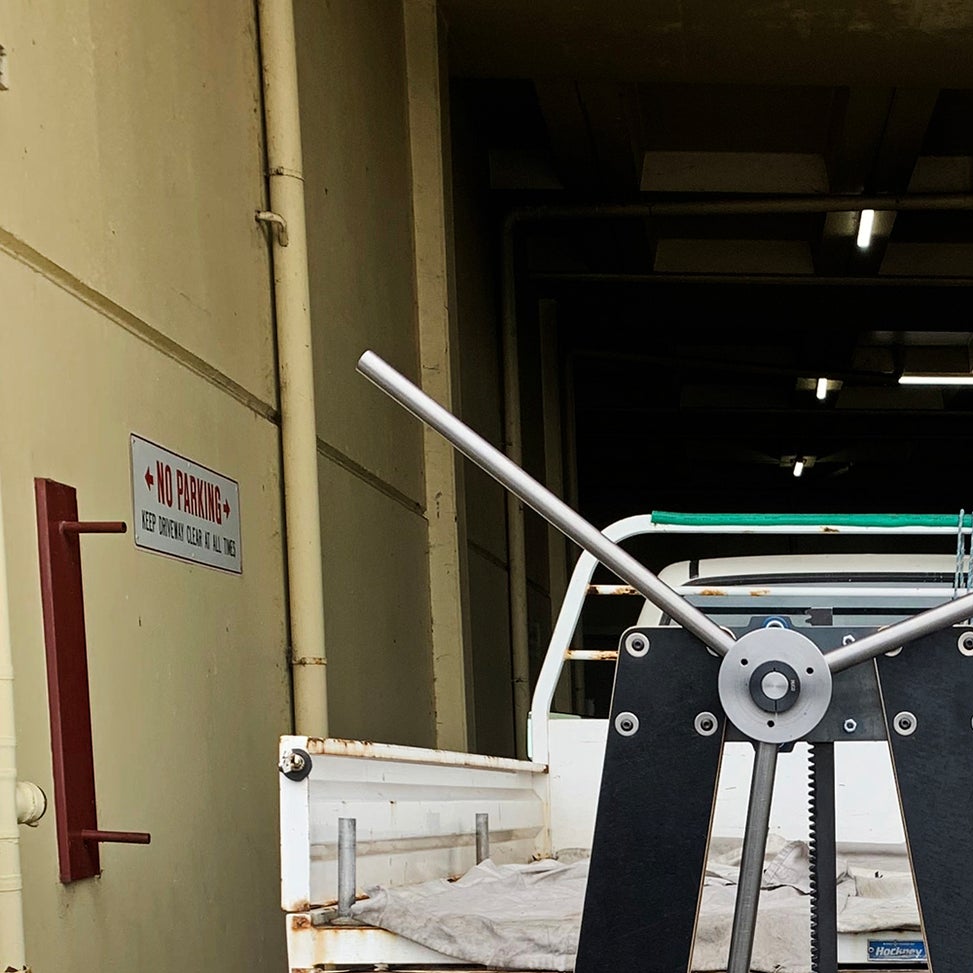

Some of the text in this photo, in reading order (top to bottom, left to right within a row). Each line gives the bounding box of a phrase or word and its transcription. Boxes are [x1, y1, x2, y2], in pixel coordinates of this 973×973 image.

[156, 460, 222, 525] NO PARKING
[141, 509, 236, 558] KEEP DRIVEWAY CLEAR AT ALL TIMES
[875, 946, 923, 959] Hockney
